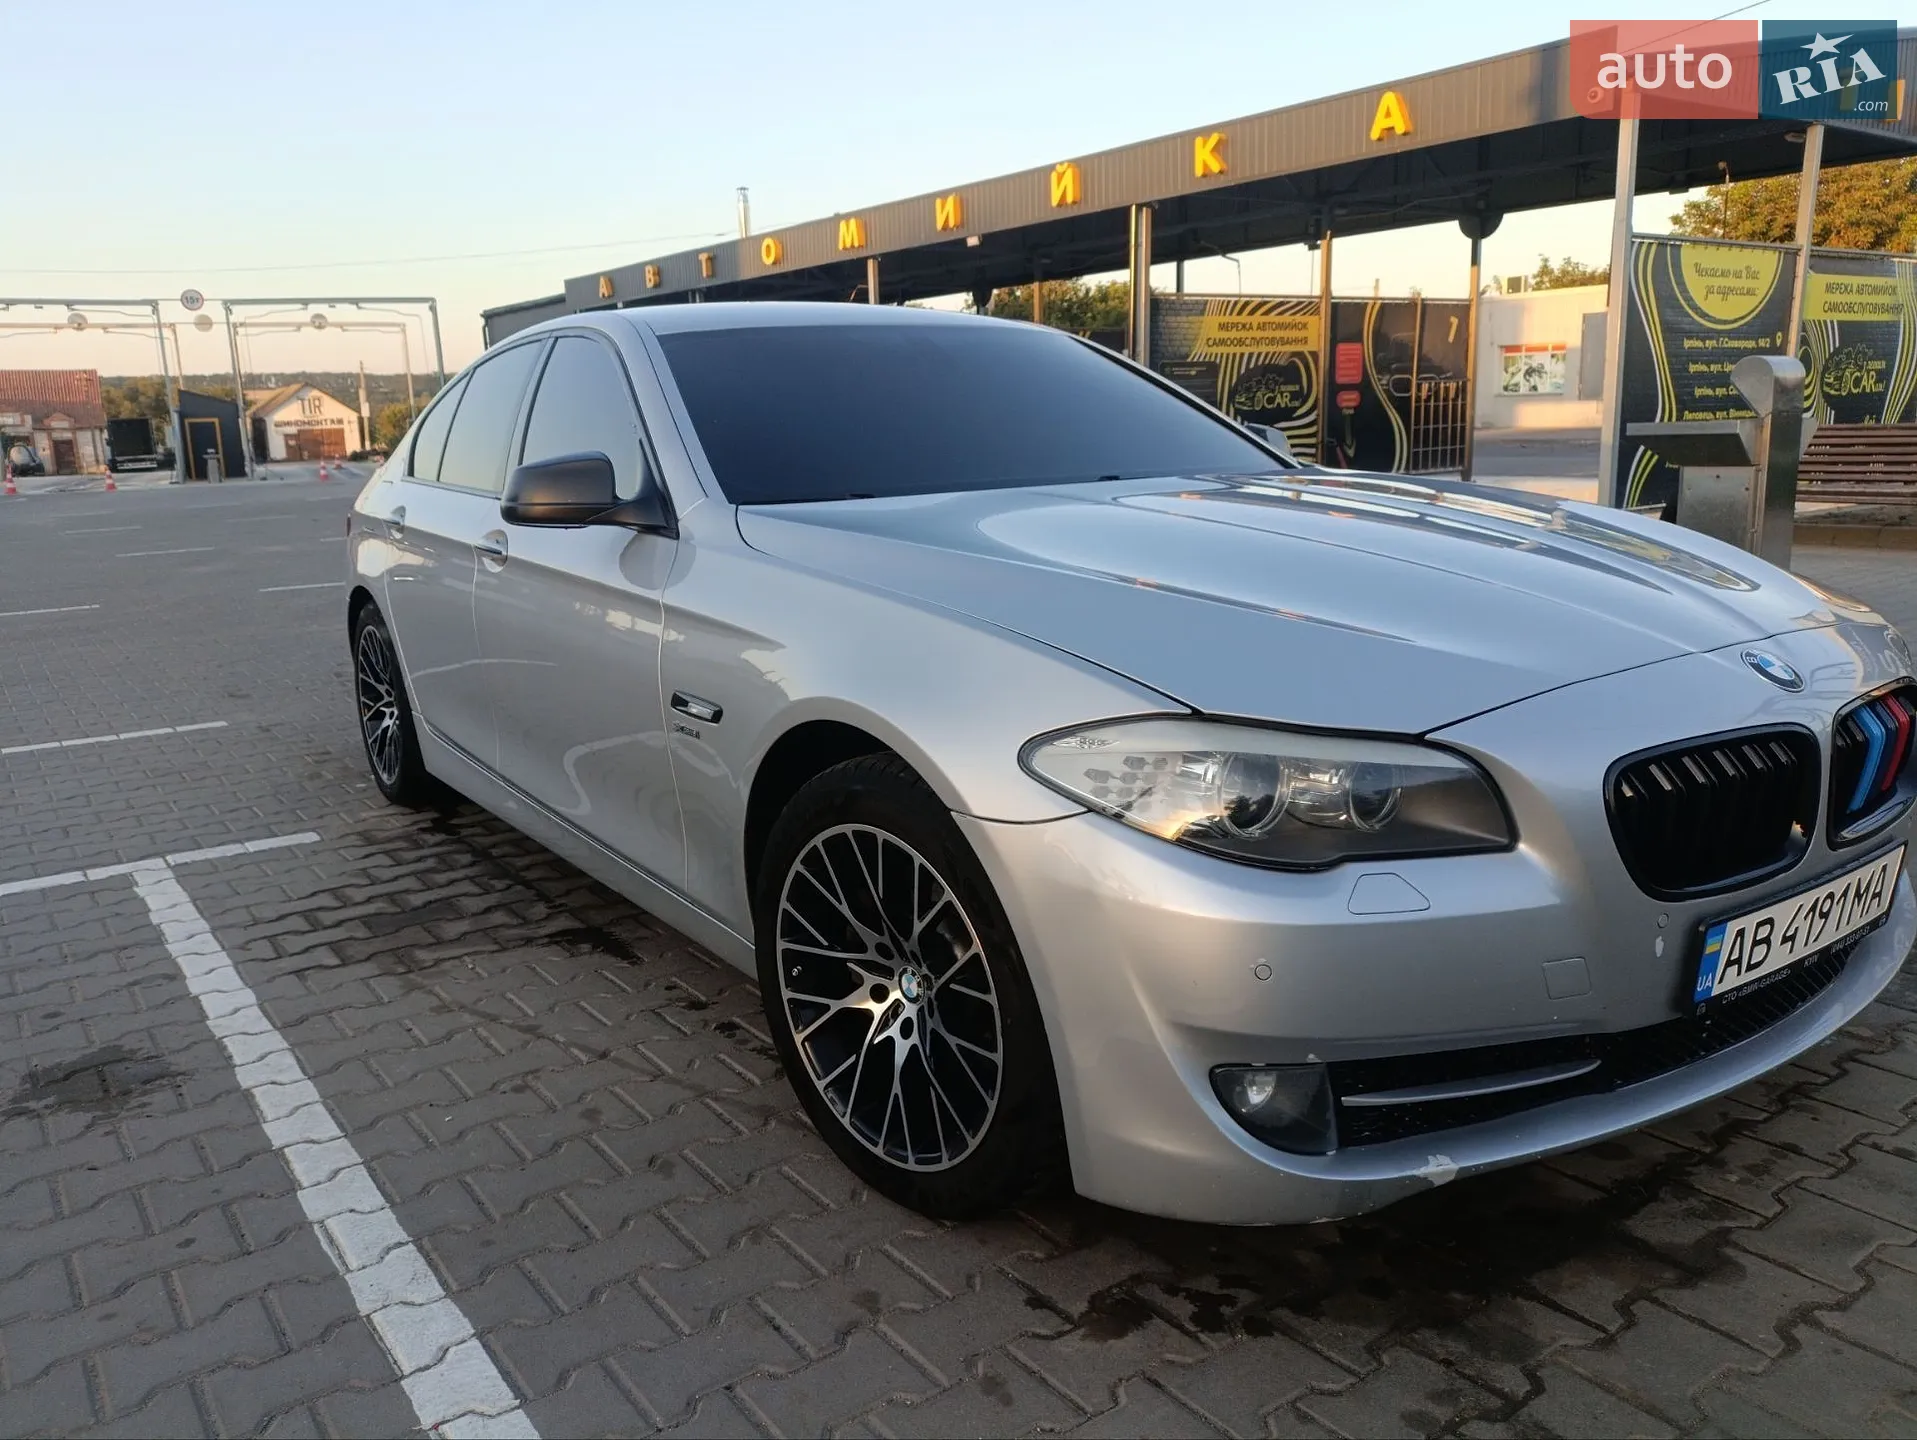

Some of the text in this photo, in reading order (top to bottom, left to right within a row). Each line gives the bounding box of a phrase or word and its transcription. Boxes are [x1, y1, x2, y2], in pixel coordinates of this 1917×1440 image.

[1694, 262, 1761, 280] Чекаємо на Вас
[1704, 285, 1715, 301] за
[1824, 281, 1898, 296] МЕРЕЖА АВТОМИЙОК
[1822, 301, 1905, 316] САМООБСЛУГОВУВАННЯ
[1218, 319, 1310, 333] МЕРЕЖА АВТОМИЙОК
[1206, 336, 1309, 348] САМООБСЛУГОВУВАННЯ
[296, 395, 324, 415] TIR
[274, 417, 344, 428] ШИНОМОНТАЖ
[1717, 862, 1888, 985] AB 4191 MA
[1697, 973, 1713, 992] UA
